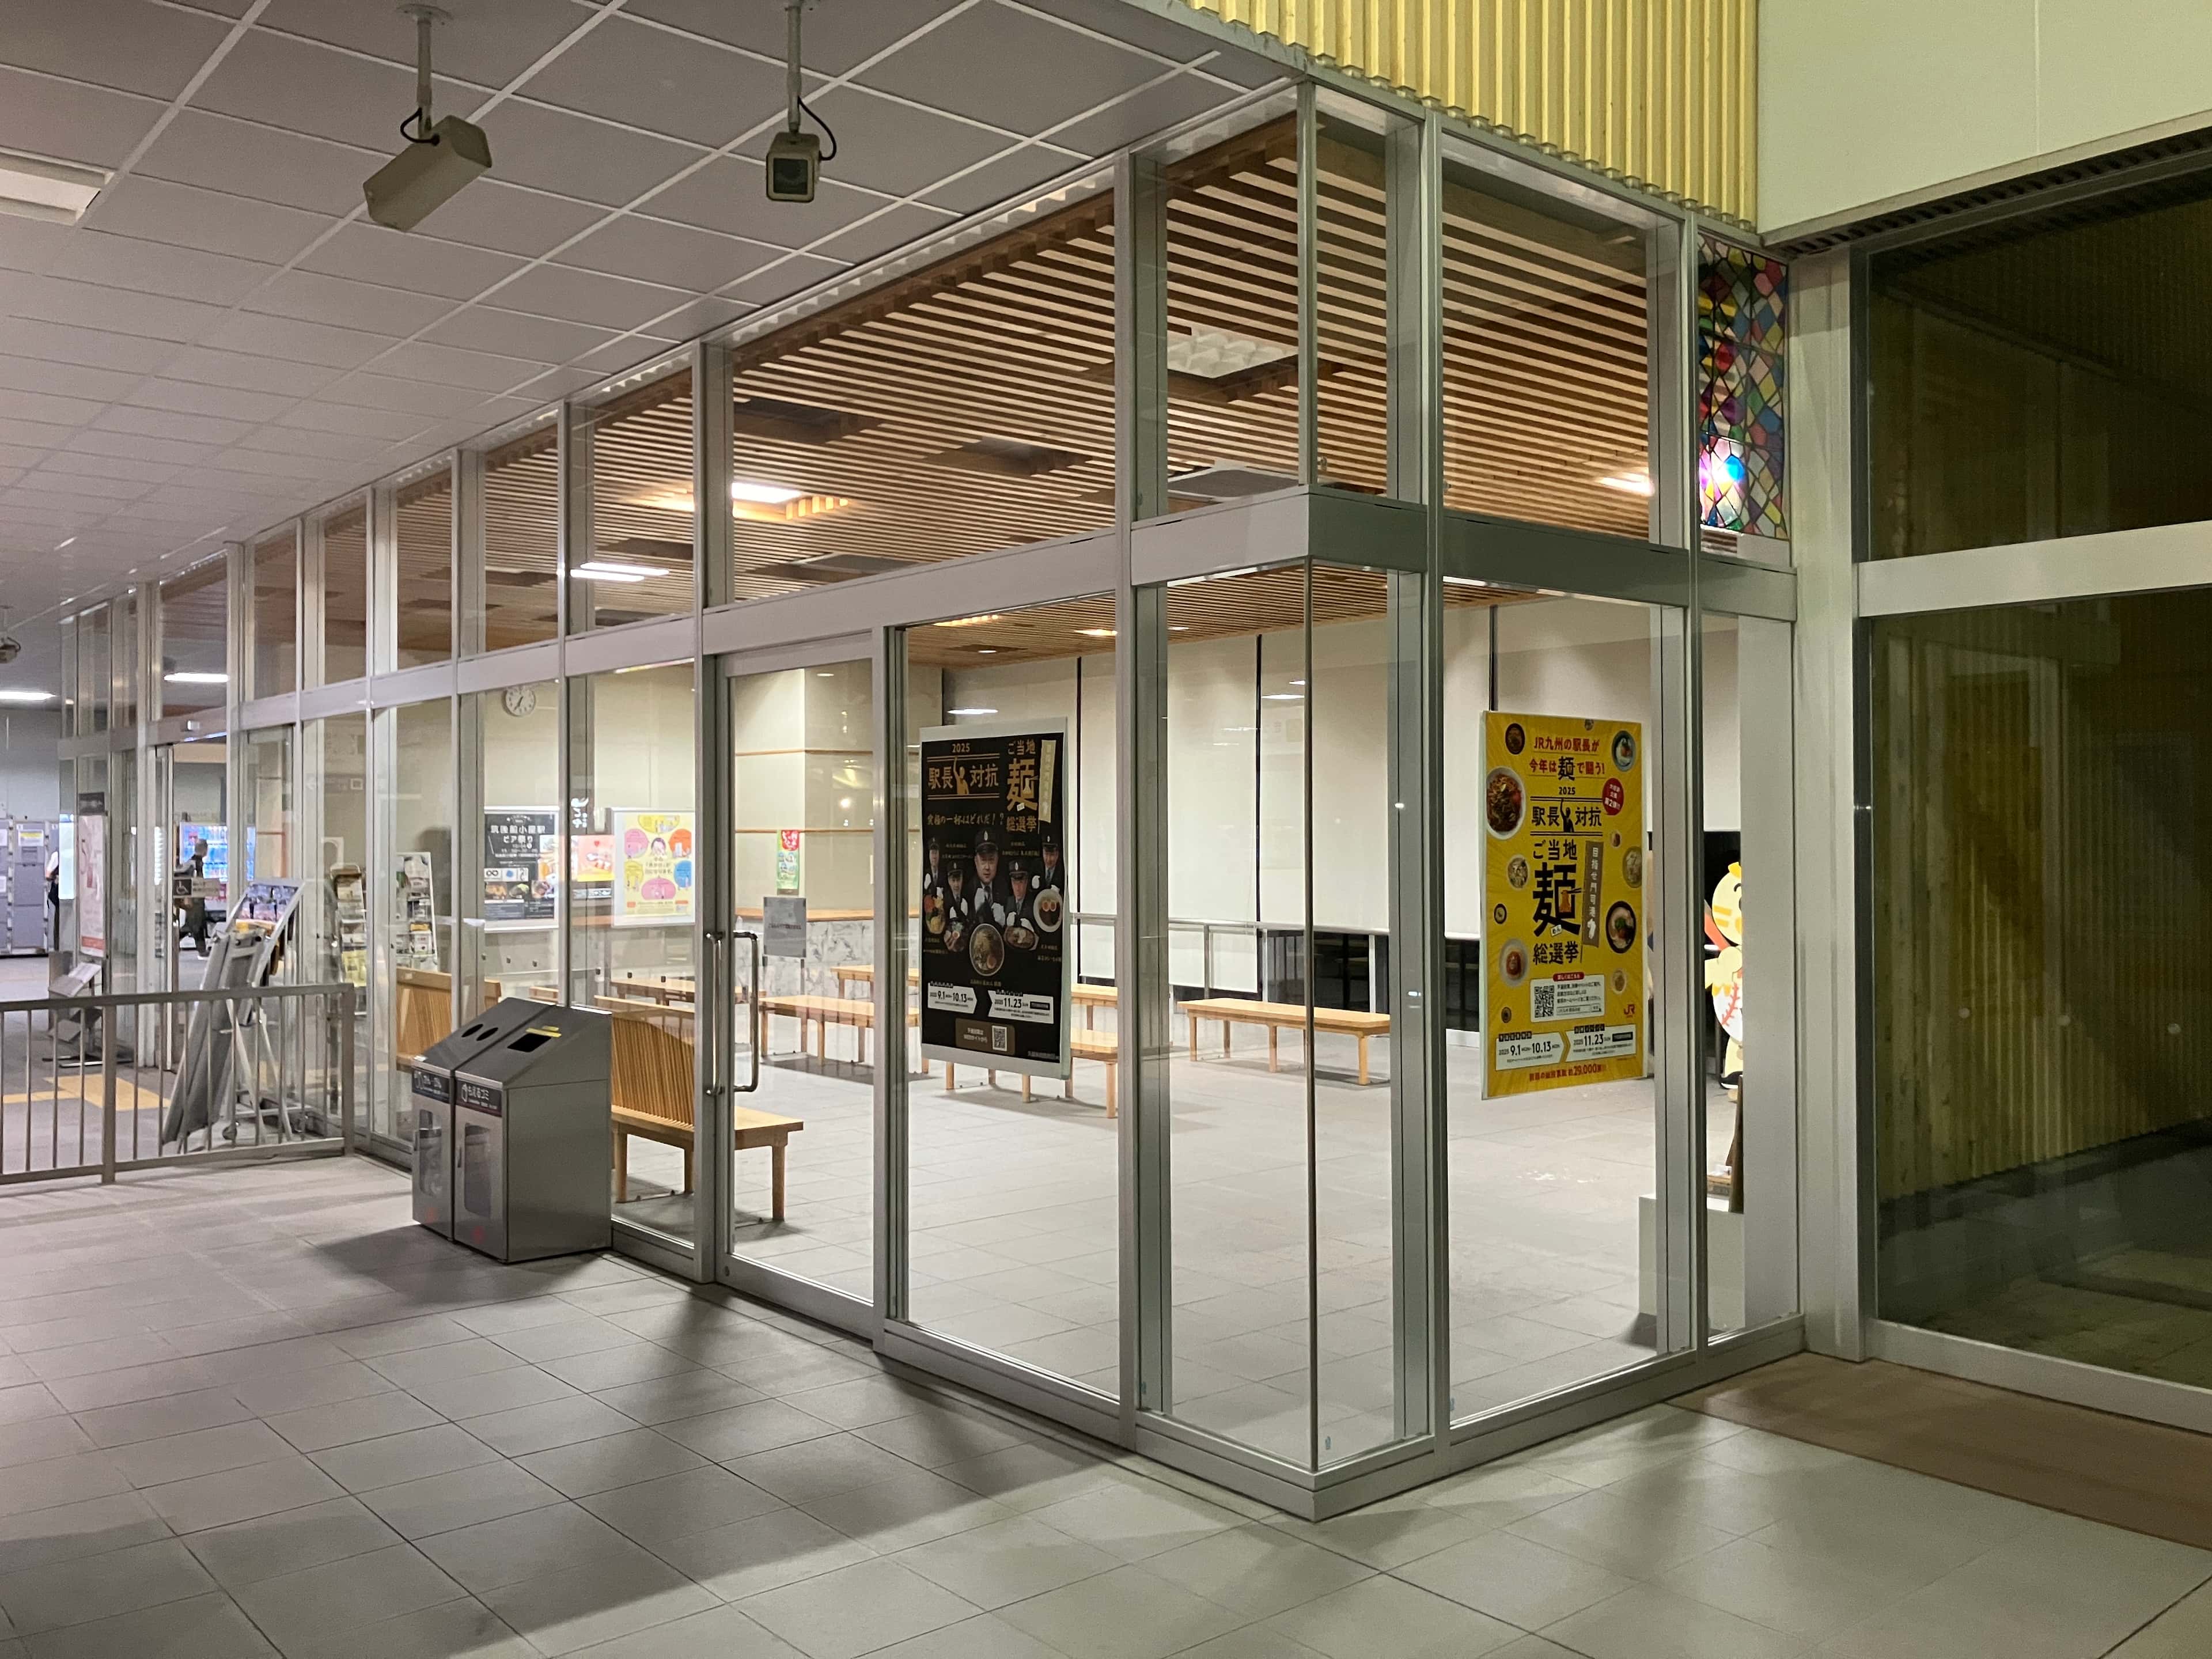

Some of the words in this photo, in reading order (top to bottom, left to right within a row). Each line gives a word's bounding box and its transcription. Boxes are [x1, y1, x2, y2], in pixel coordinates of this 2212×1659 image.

[952, 743, 970, 753] 2025
[1007, 740, 1036, 755] ご当地
[1533, 736, 1600, 752] JR九州の駅長が
[927, 767, 953, 789] 駅長
[969, 763, 999, 788] 対抗
[1529, 756, 1605, 781] 今年は麺で闘う!
[1006, 757, 1039, 812] 麺
[1558, 786, 1575, 796] 2025
[1006, 816, 1037, 833] 総選挙
[1532, 806, 1560, 827] 駅長
[1575, 806, 1601, 827] 対抗
[1533, 839, 1578, 861] ご当地
[1533, 862, 1581, 937] 麺
[1533, 941, 1579, 965] 総選挙
[1004, 998, 1022, 1008] 11.23
[1623, 1004, 1635, 1015] JR
[1510, 1044, 1521, 1056] 9.1
[1532, 1041, 1551, 1054] 10.13
[1584, 1034, 1604, 1047] 11.23
